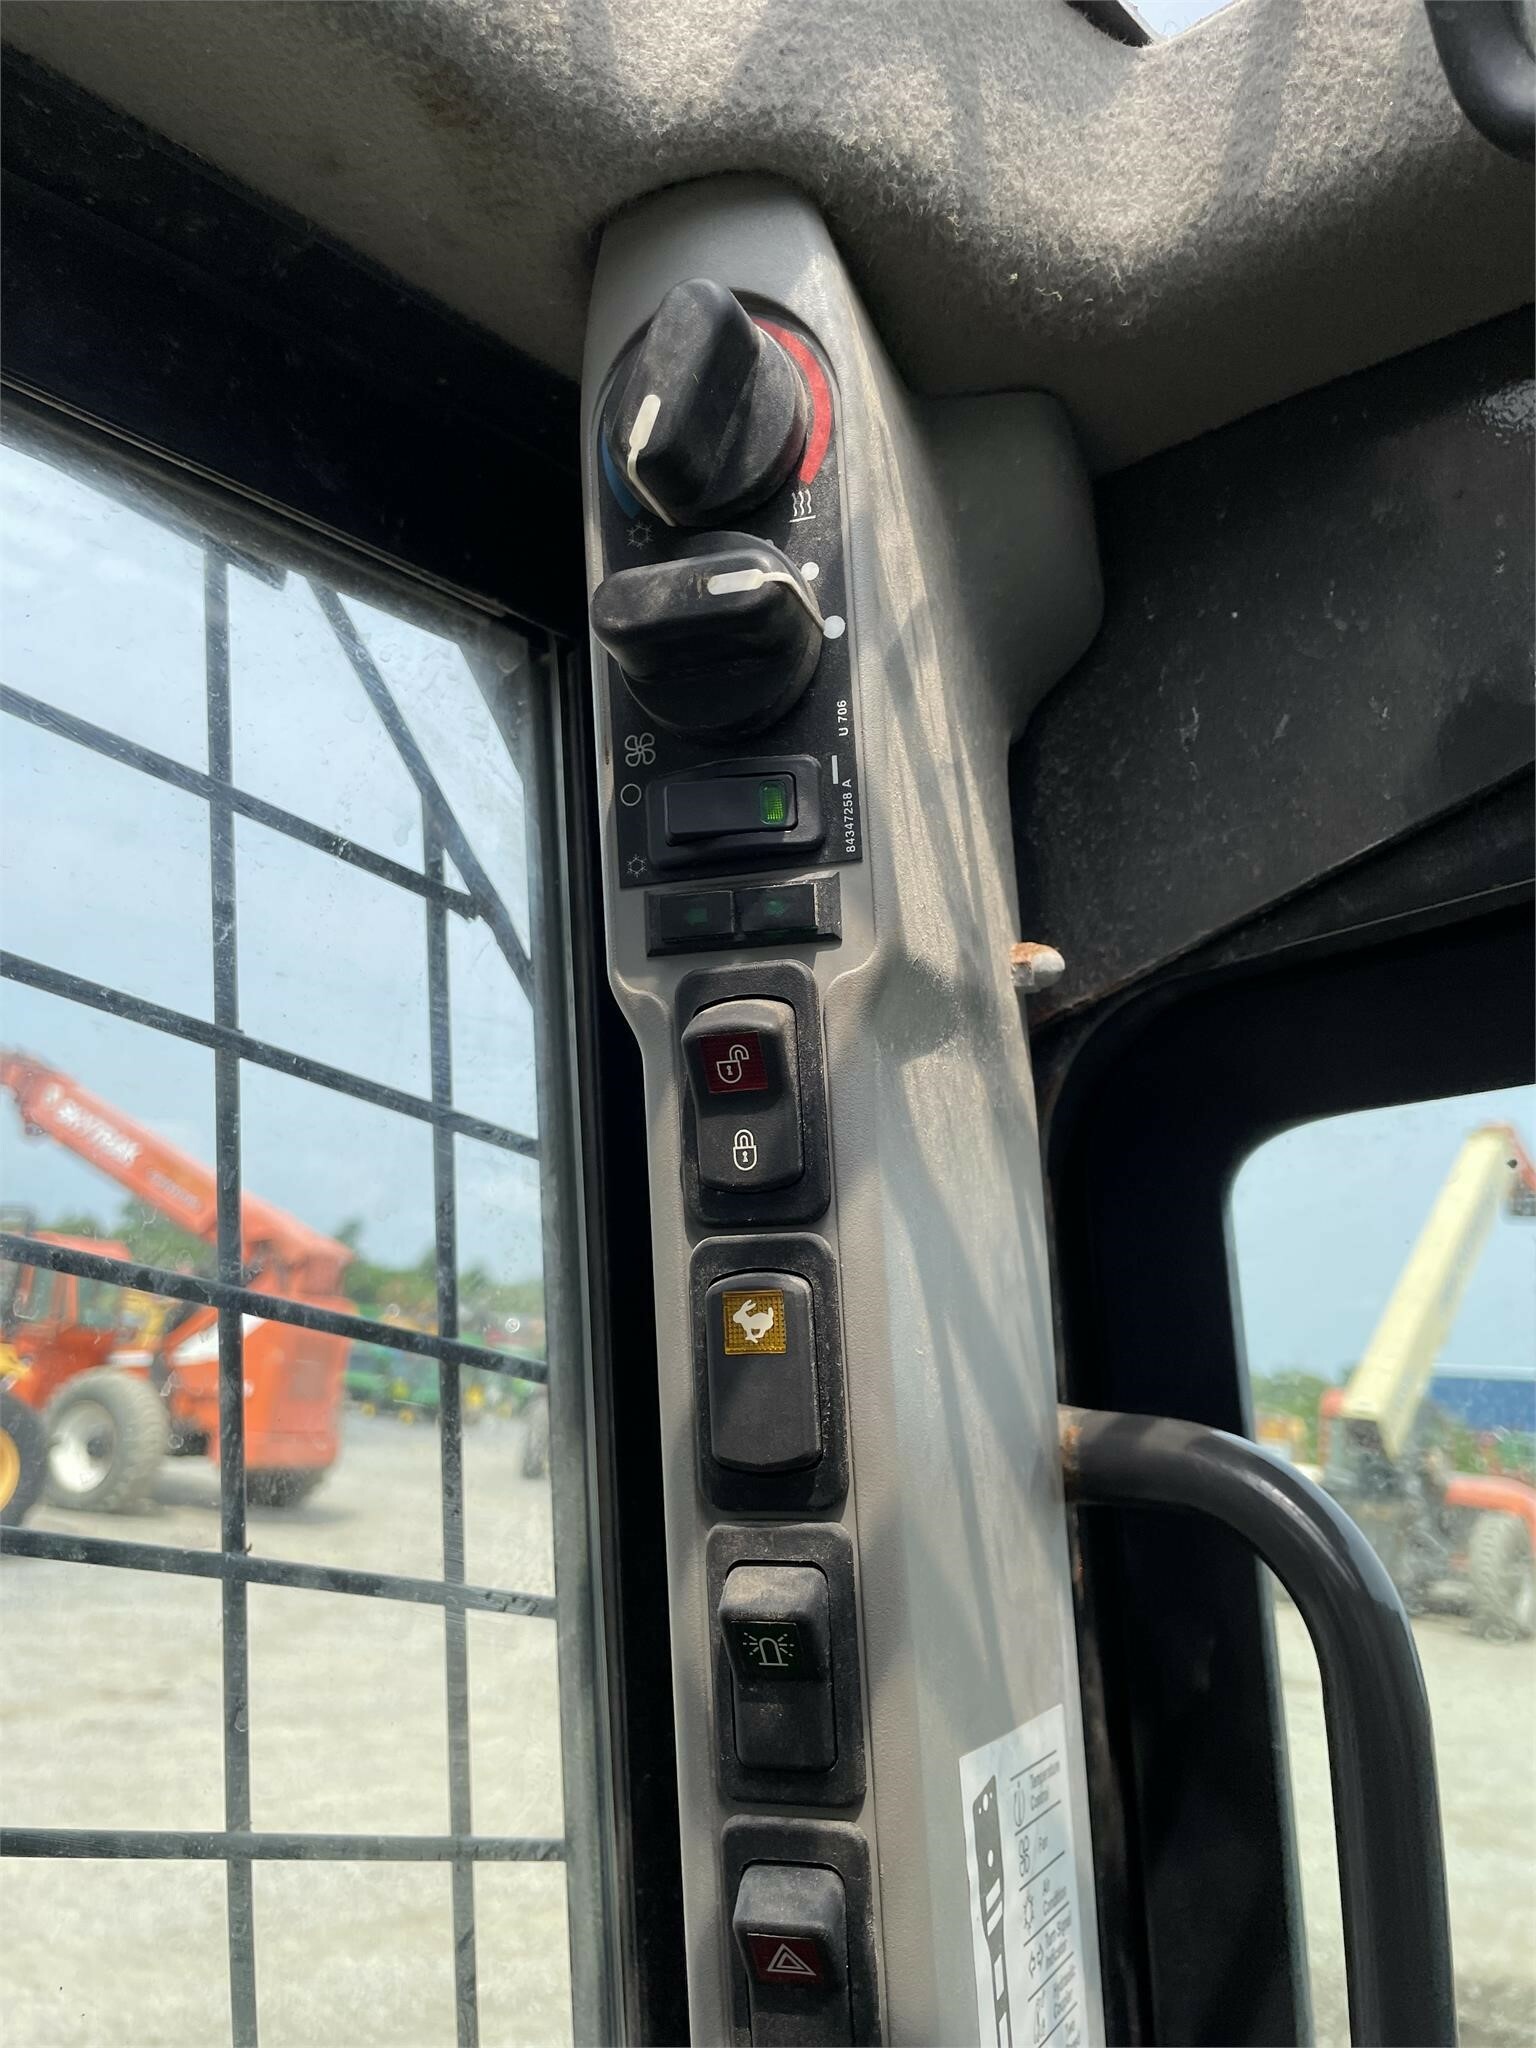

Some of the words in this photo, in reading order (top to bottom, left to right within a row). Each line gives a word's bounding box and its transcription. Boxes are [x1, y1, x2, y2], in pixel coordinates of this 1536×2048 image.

[837, 700, 848, 723] 706
[838, 726, 849, 737] U
[841, 779, 852, 788] A
[842, 792, 856, 853] 84347258
